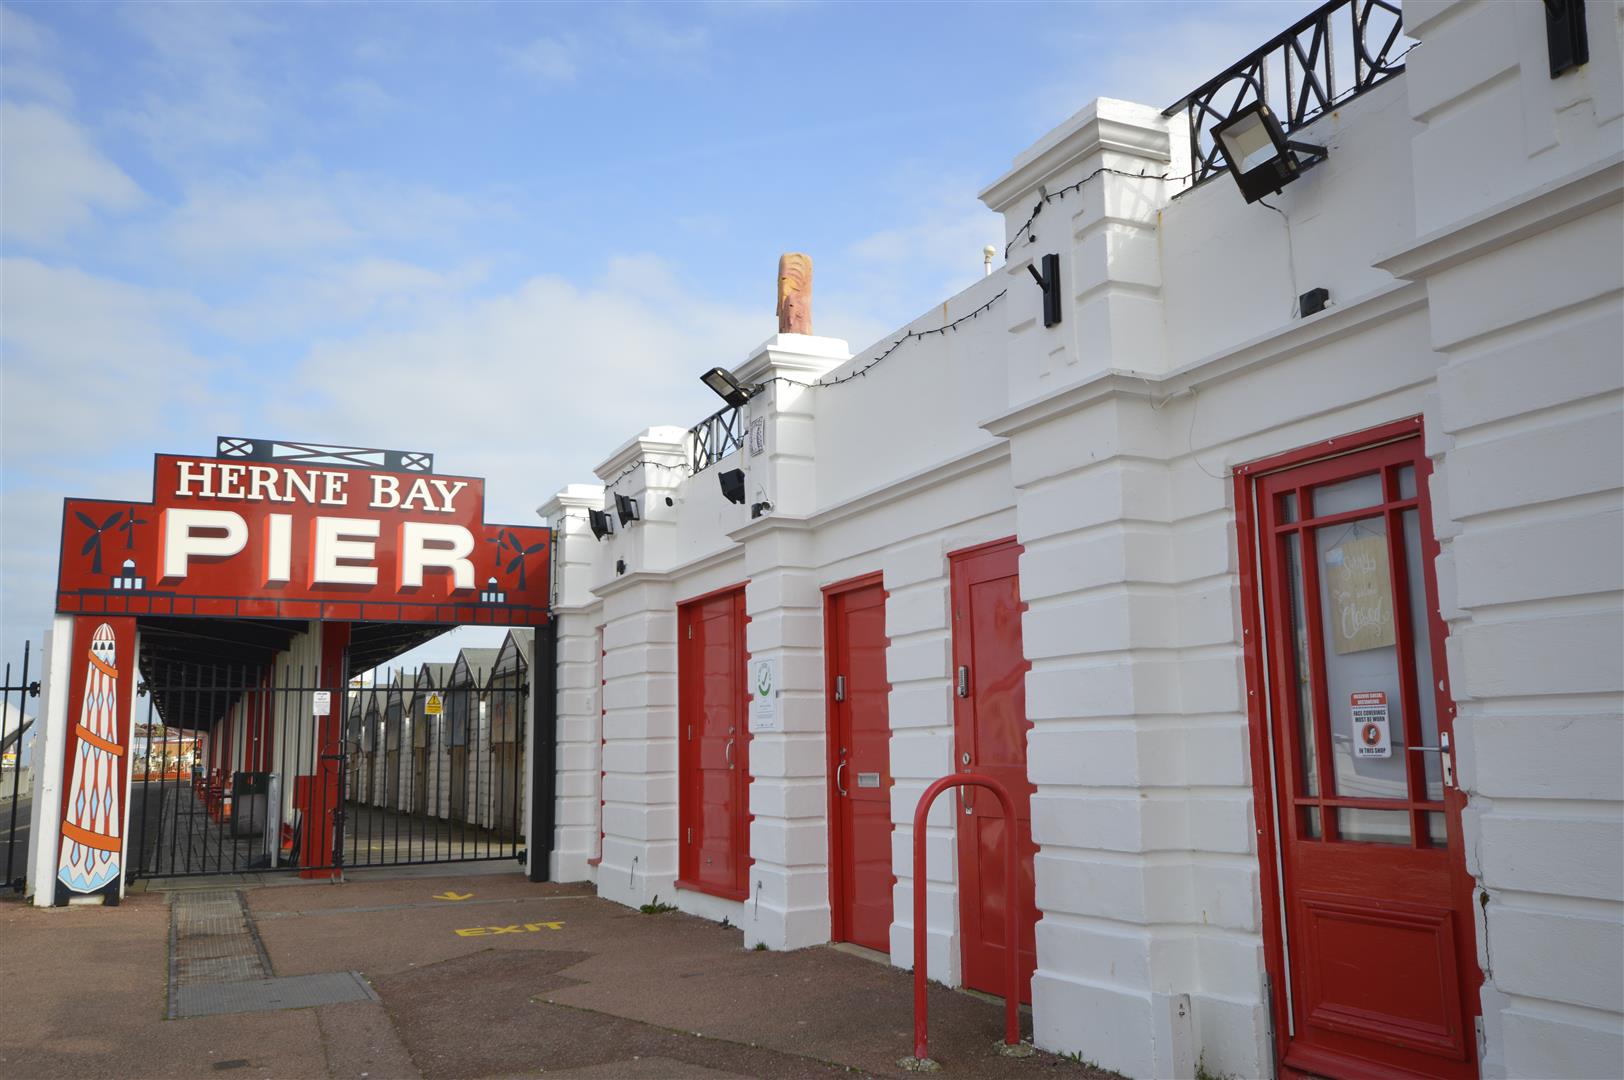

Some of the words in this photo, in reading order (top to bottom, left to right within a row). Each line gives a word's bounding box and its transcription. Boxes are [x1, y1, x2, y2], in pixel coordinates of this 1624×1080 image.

[175, 461, 348, 505] HERNE
[369, 475, 468, 512] BAY
[159, 507, 476, 592] PIER
[1341, 597, 1389, 639] Closed
[454, 921, 566, 937] EXIT
